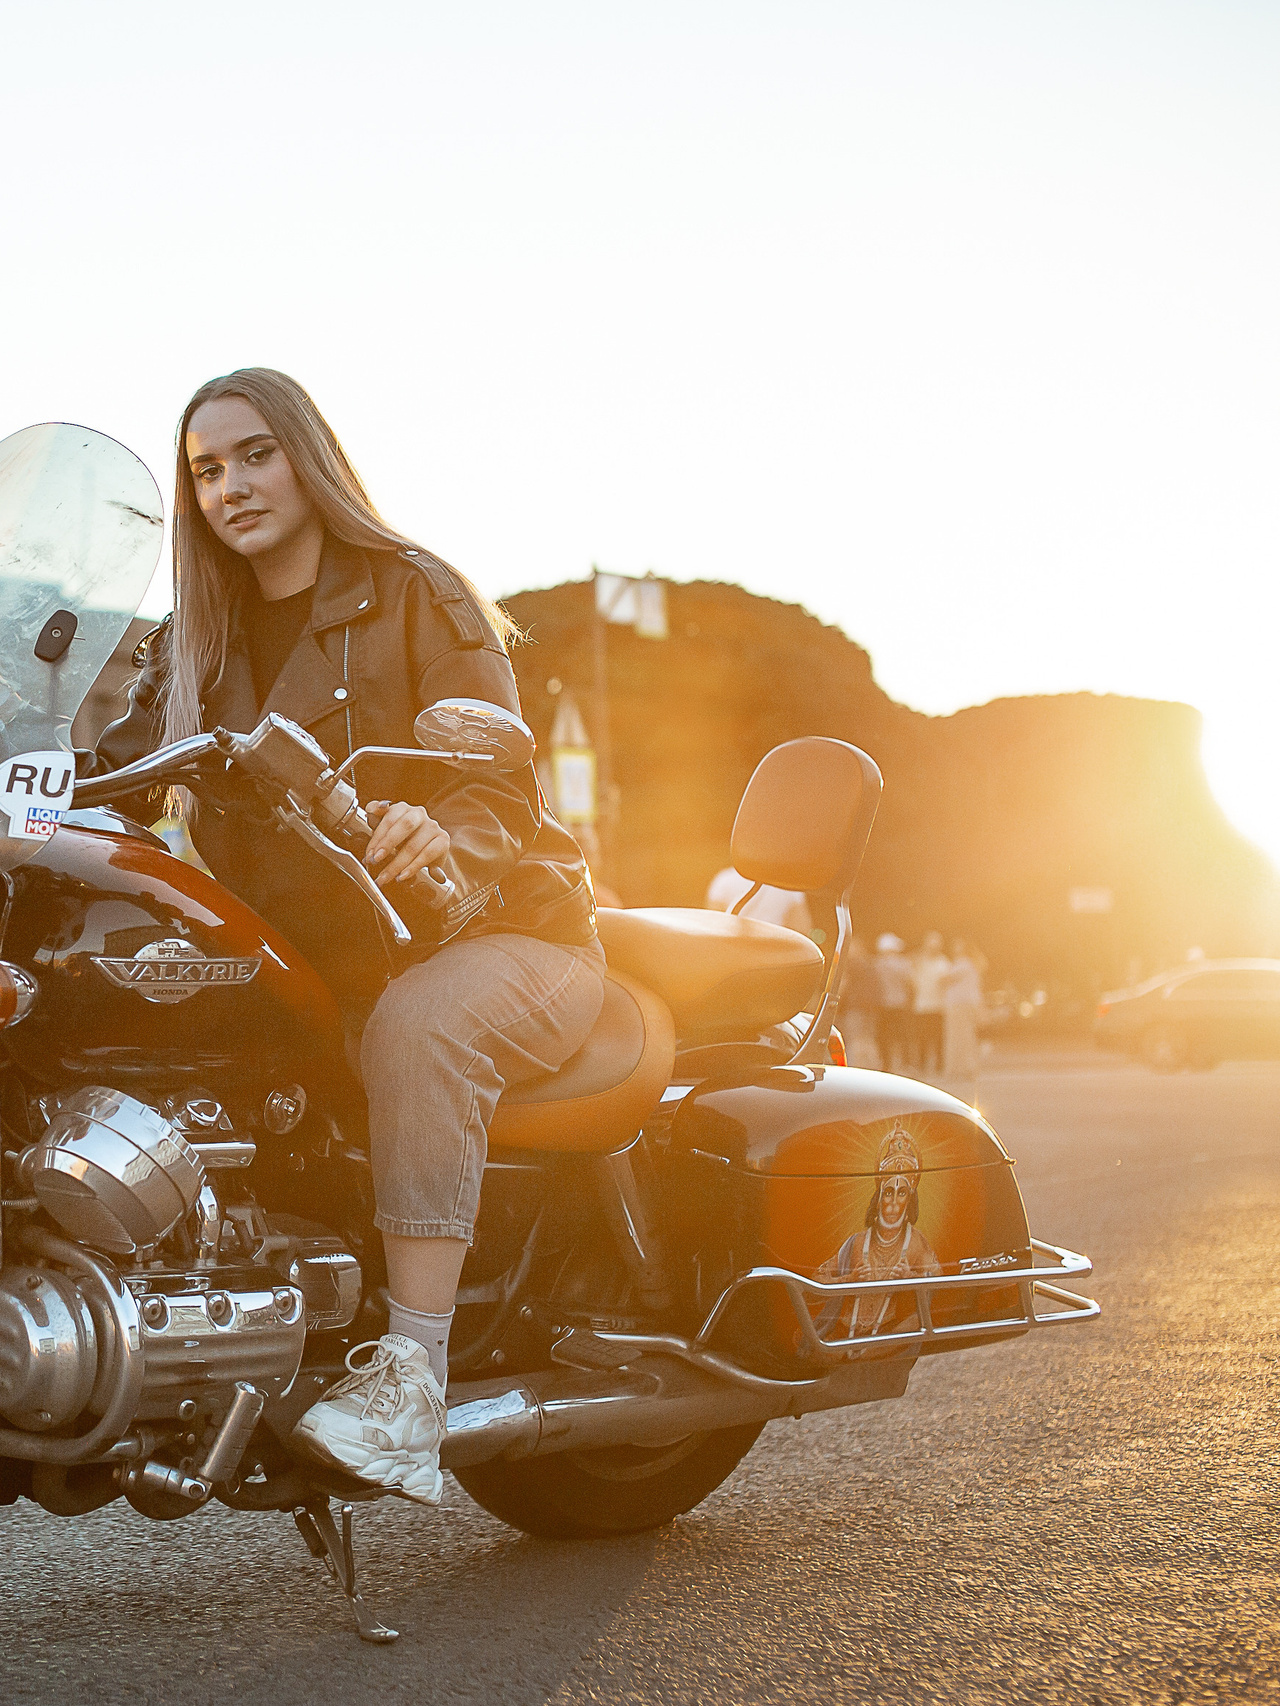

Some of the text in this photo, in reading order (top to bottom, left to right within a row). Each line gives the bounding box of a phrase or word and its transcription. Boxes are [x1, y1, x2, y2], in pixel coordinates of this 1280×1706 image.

[5, 763, 72, 798] RU
[110, 962, 251, 981] VALKYRIE
[152, 988, 189, 996] HONDA
[384, 1337, 409, 1350] FABIANA
